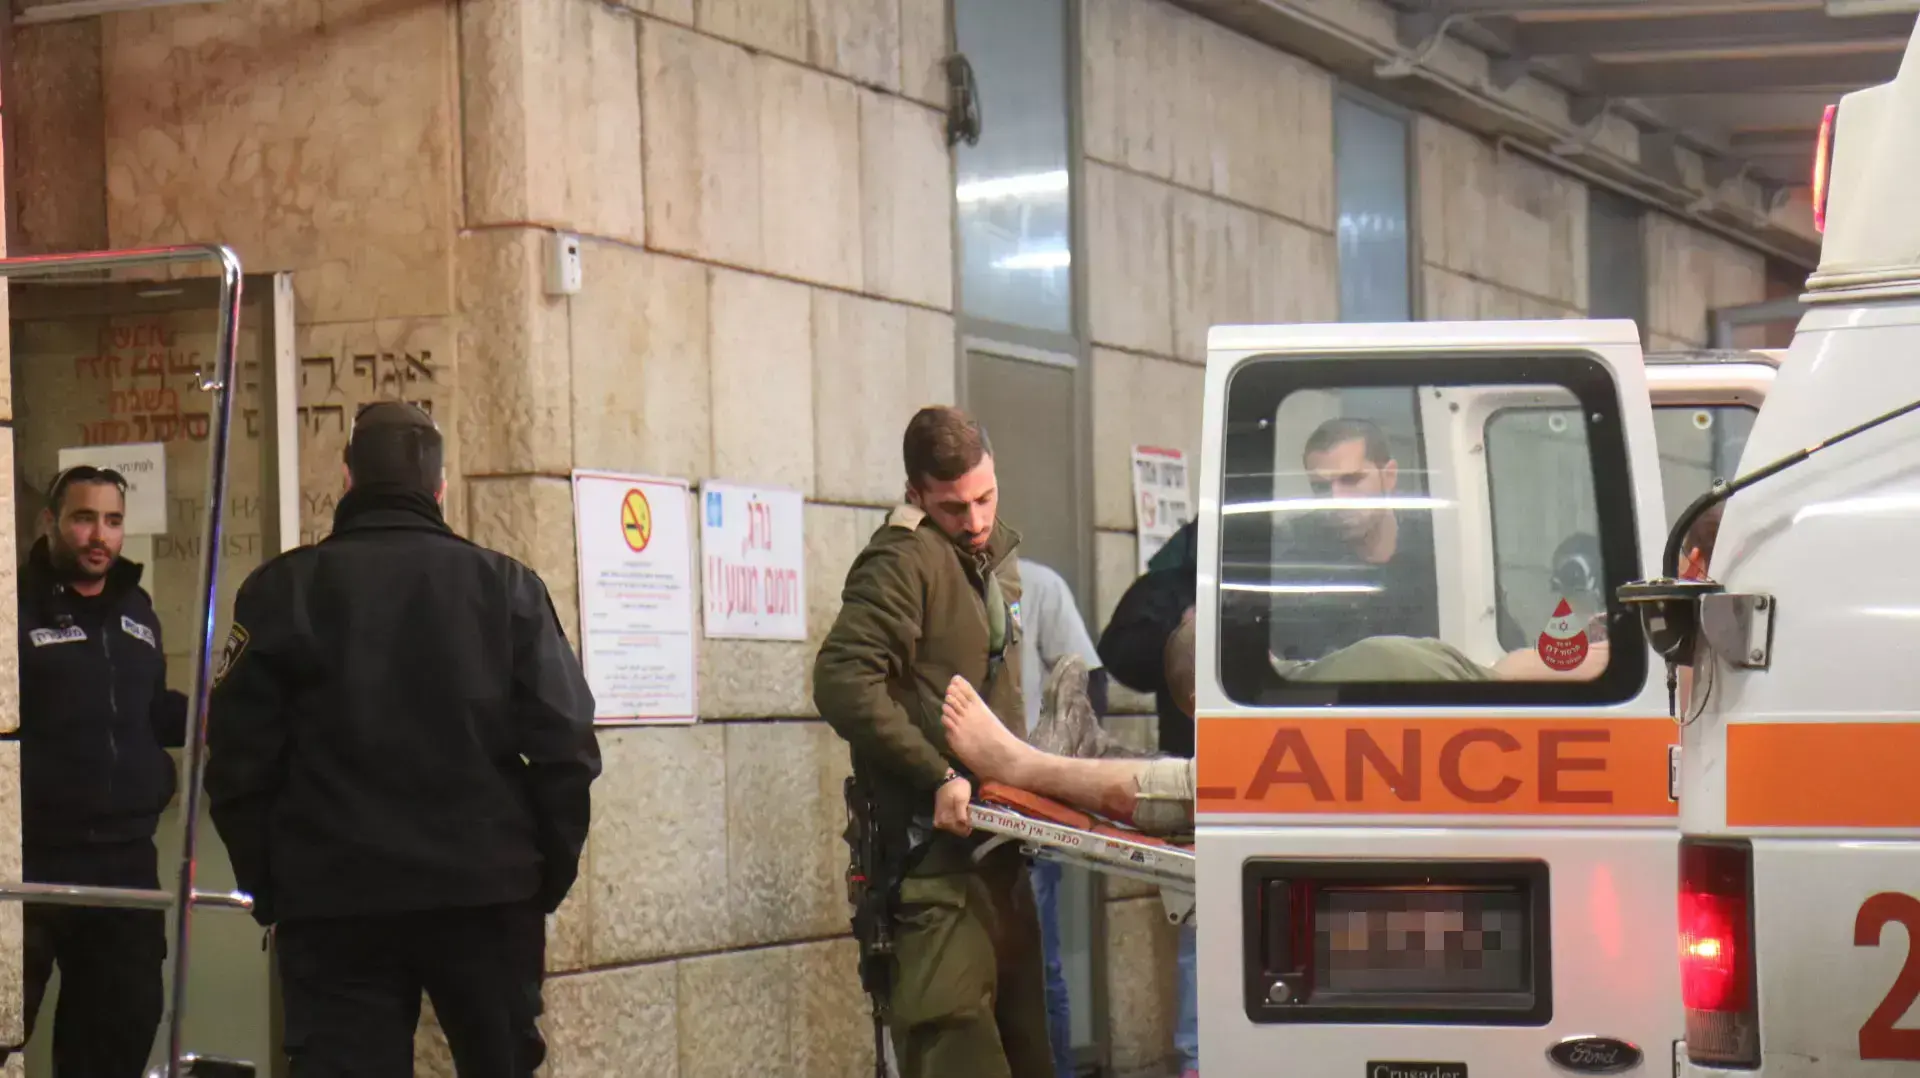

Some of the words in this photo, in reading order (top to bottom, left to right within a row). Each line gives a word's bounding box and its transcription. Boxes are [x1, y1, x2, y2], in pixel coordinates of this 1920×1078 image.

[998, 816, 1027, 831] לאחוז
[1028, 825, 1044, 837] אין
[1053, 834, 1080, 846] סכנה
[1854, 891, 1920, 1060] 2
[1570, 1041, 1618, 1064] Ford
